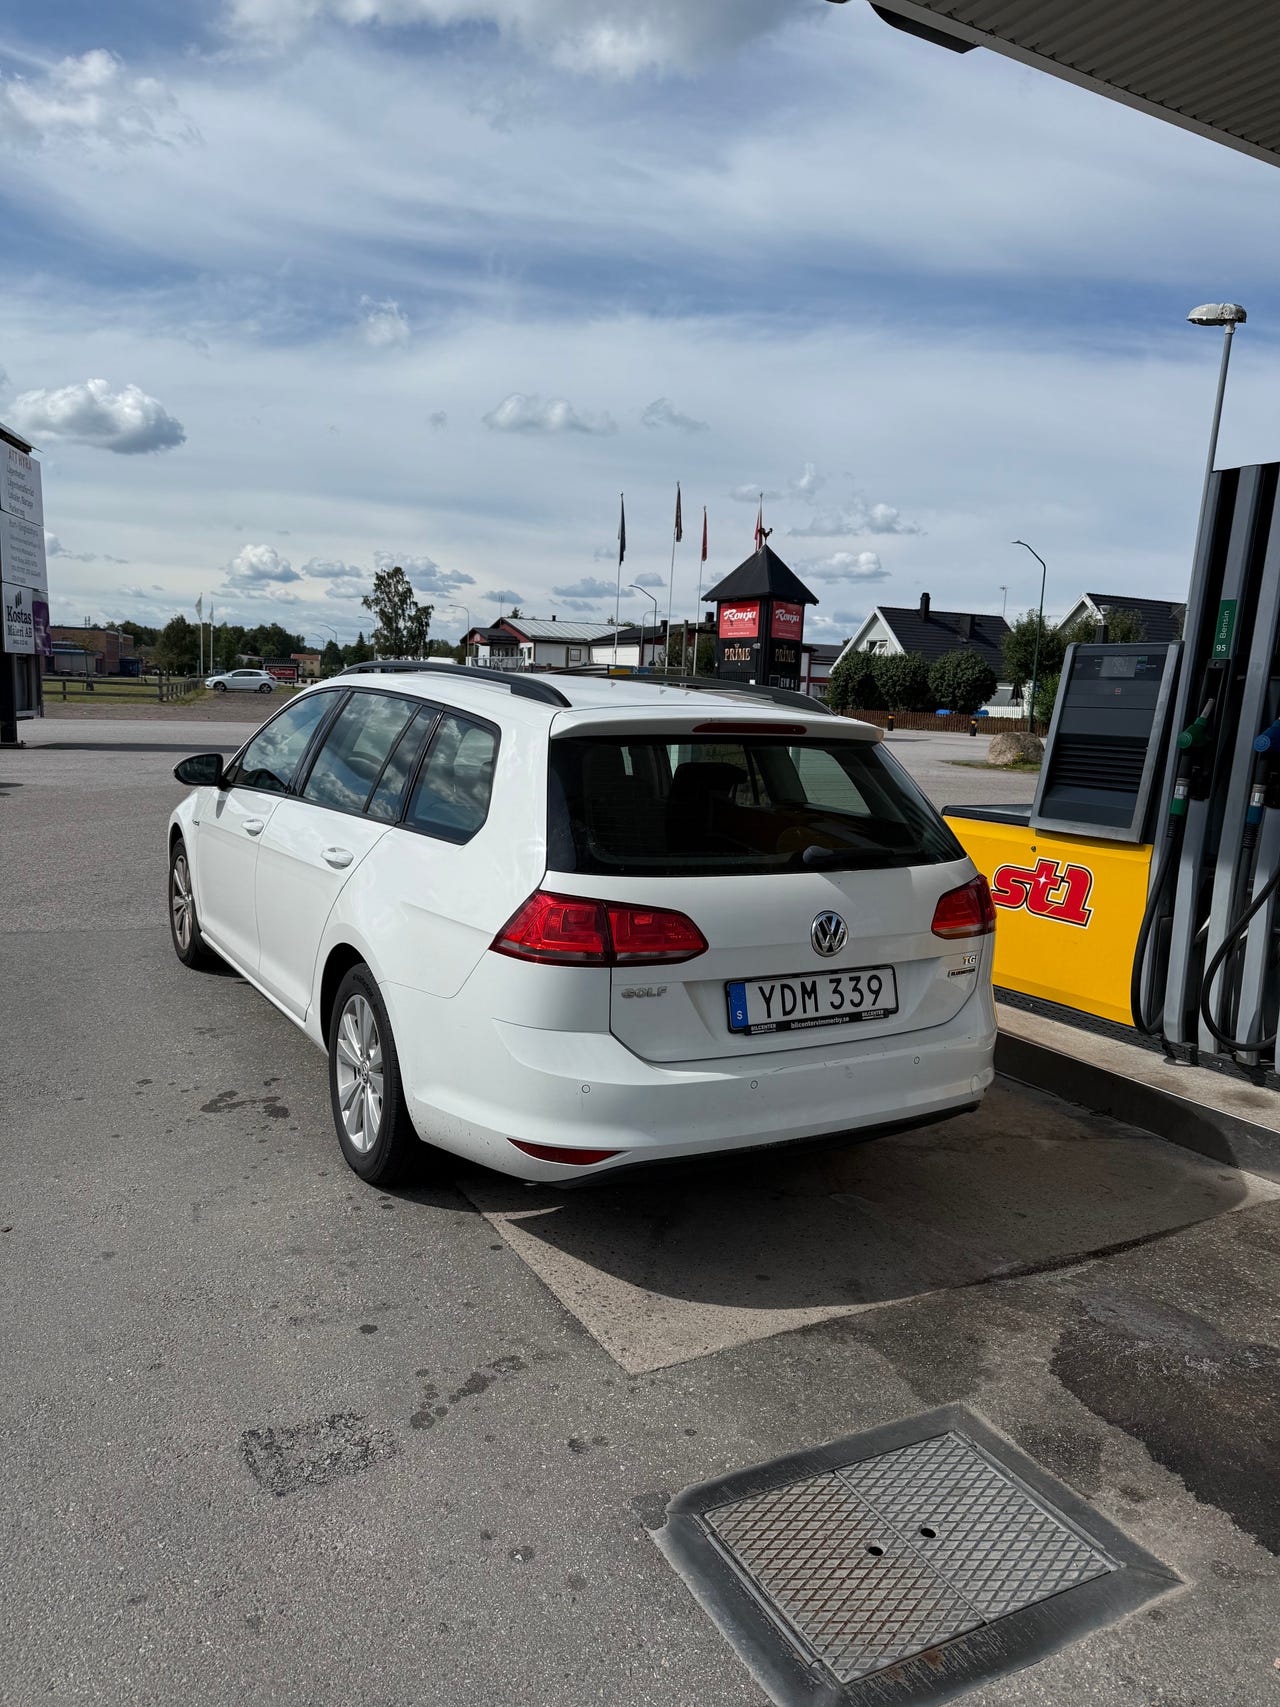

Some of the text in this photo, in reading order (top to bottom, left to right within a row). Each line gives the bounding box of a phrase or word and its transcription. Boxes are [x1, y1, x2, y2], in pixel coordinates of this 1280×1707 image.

[6, 605, 32, 625] Kostas
[723, 608, 756, 621] Ronja
[775, 608, 800, 624] Ronja
[1219, 610, 1230, 639] Bensin
[724, 647, 751, 661] PRIME
[775, 648, 796, 662] PRIME
[1216, 644, 1227, 652] 95
[991, 857, 1095, 929] st1
[621, 985, 668, 999] GOLF
[758, 974, 883, 1019] YDM 339
[736, 1010, 743, 1020] S
[790, 1016, 850, 1029] bilcentervimmerby.se
